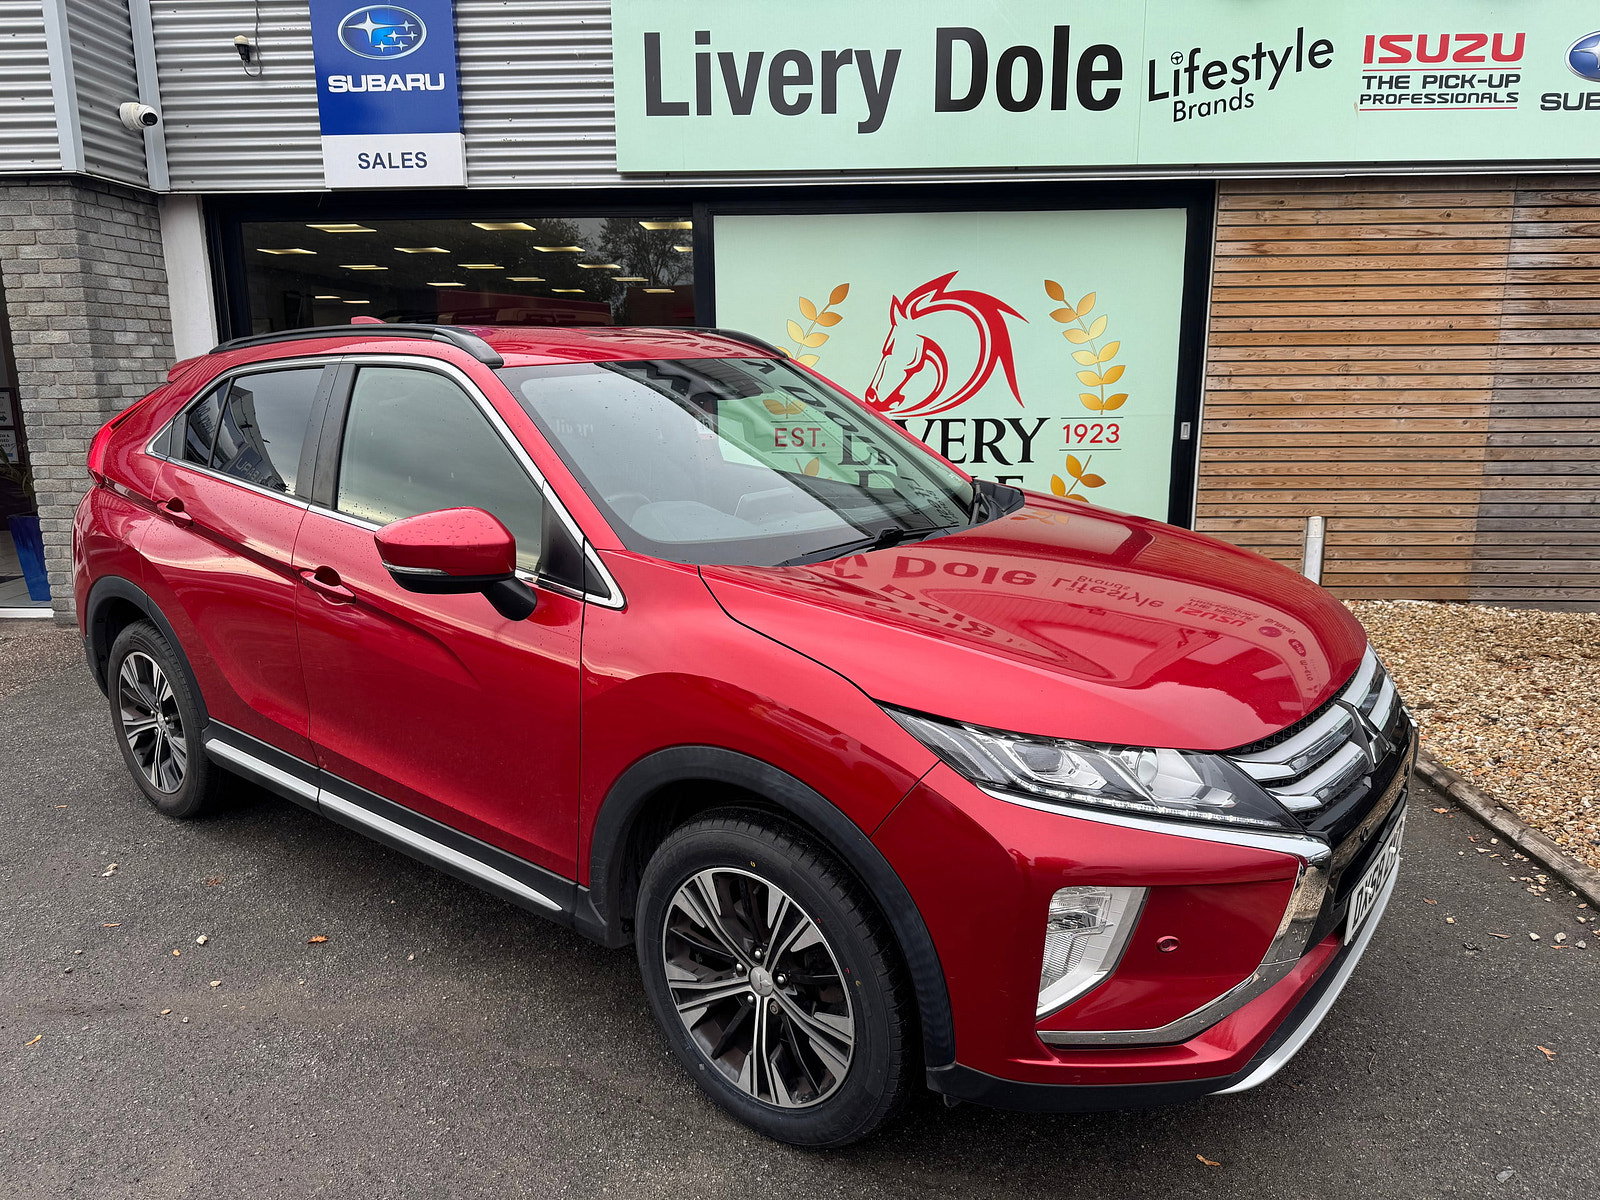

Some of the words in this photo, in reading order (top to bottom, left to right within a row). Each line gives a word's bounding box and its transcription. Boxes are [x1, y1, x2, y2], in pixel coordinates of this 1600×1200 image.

[1363, 33, 1526, 64] ISUZU
[1149, 27, 1334, 102] Lifestyle
[327, 73, 445, 93] SUBARU
[644, 30, 902, 134] Livery
[935, 25, 1124, 113] Dole
[1362, 74, 1411, 90] THE
[1422, 73, 1521, 90] PICK-UP
[1173, 88, 1255, 122] Brands
[1360, 92, 1519, 105] PROFESSIONALS
[357, 152, 428, 169] SALES
[774, 427, 826, 447] EST.
[1062, 423, 1120, 444] 1923
